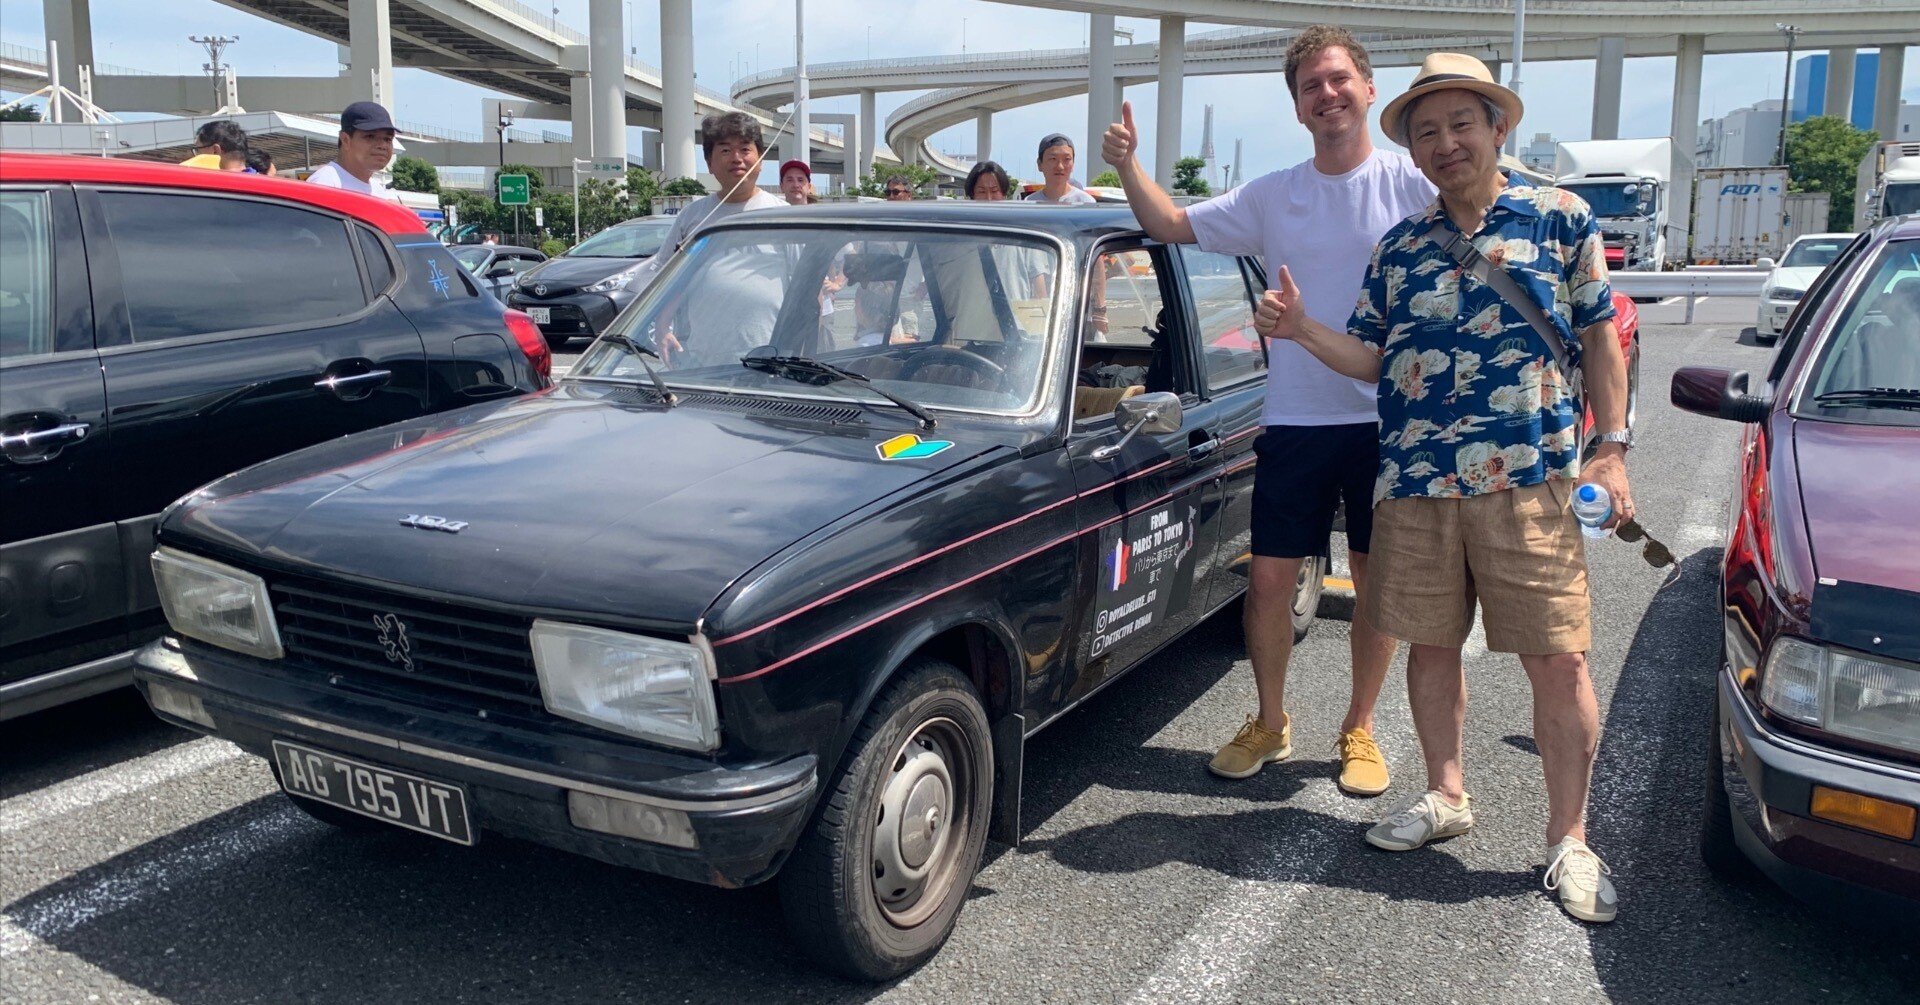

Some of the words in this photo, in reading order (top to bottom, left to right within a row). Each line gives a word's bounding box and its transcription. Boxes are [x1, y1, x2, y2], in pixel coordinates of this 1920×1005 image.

[1150, 510, 1168, 531] FROM
[1132, 535, 1152, 556] PARIS
[1153, 530, 1162, 547] TO
[1163, 521, 1183, 543] TOKYO
[1133, 543, 1179, 574] パリから東京まで
[1148, 567, 1162, 584] 車で
[1108, 589, 1157, 624] ROYALDELUXE_GTI
[1104, 621, 1134, 648] DETECTIVE
[288, 749, 329, 797] AG
[333, 761, 401, 819] 795
[408, 781, 451, 834] VT
